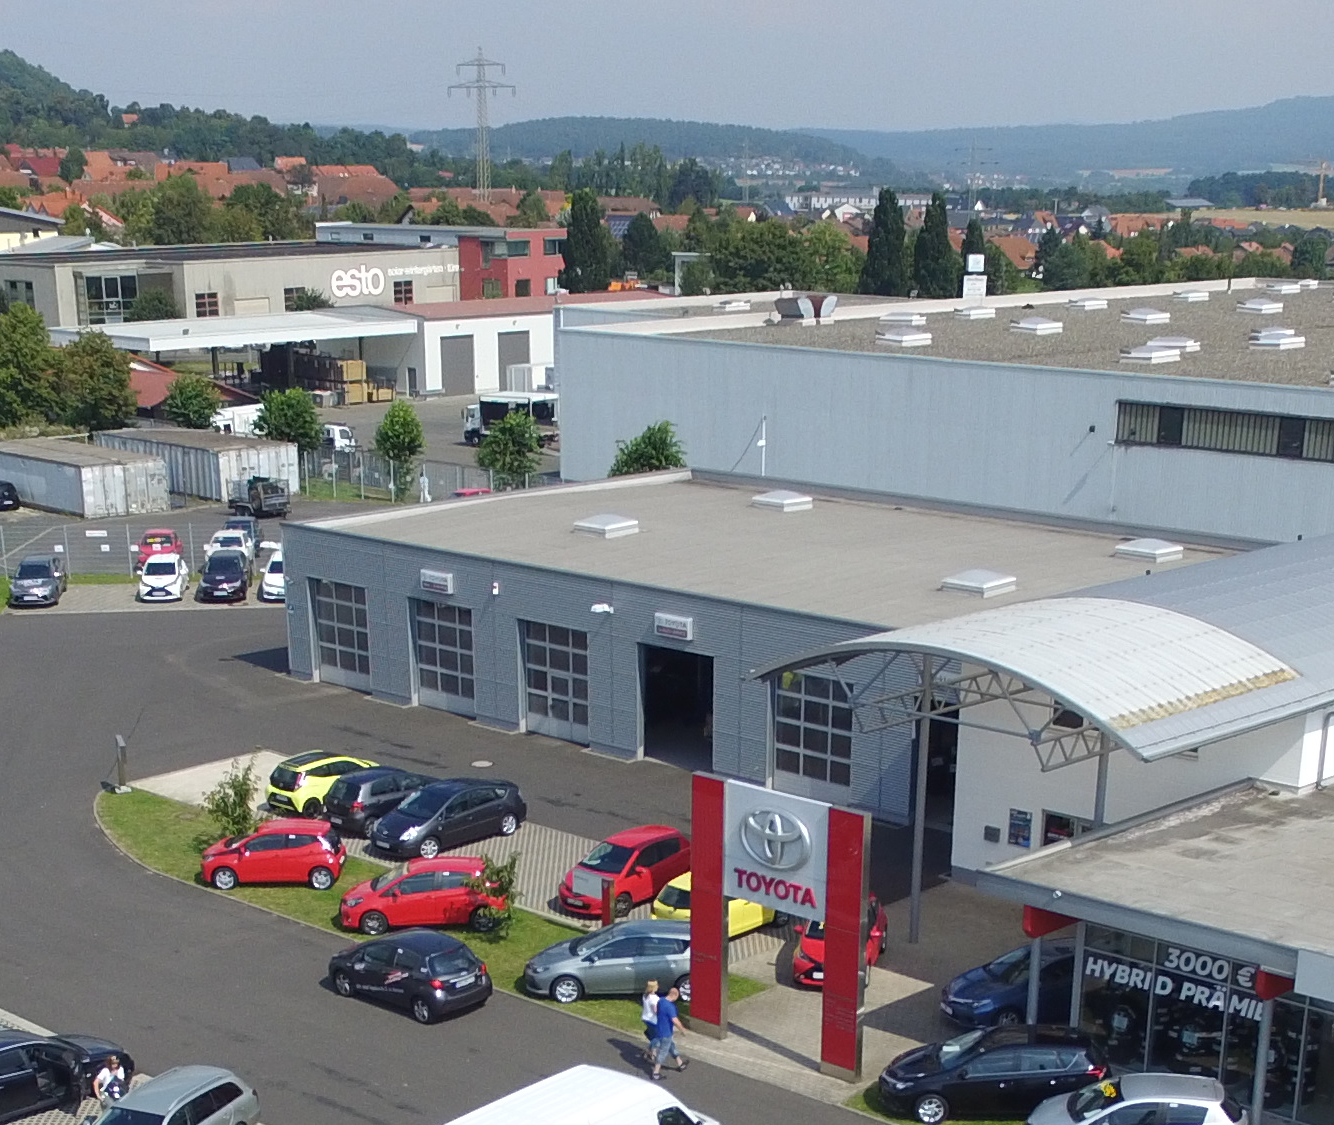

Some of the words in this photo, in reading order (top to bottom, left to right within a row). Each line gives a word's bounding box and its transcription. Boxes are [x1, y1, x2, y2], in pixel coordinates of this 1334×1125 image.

[330, 264, 385, 298] esto
[734, 867, 817, 909] TOYOTA
[1085, 957, 1173, 996] HYBRID
[1164, 947, 1230, 980] 3000
[1236, 966, 1257, 987] €
